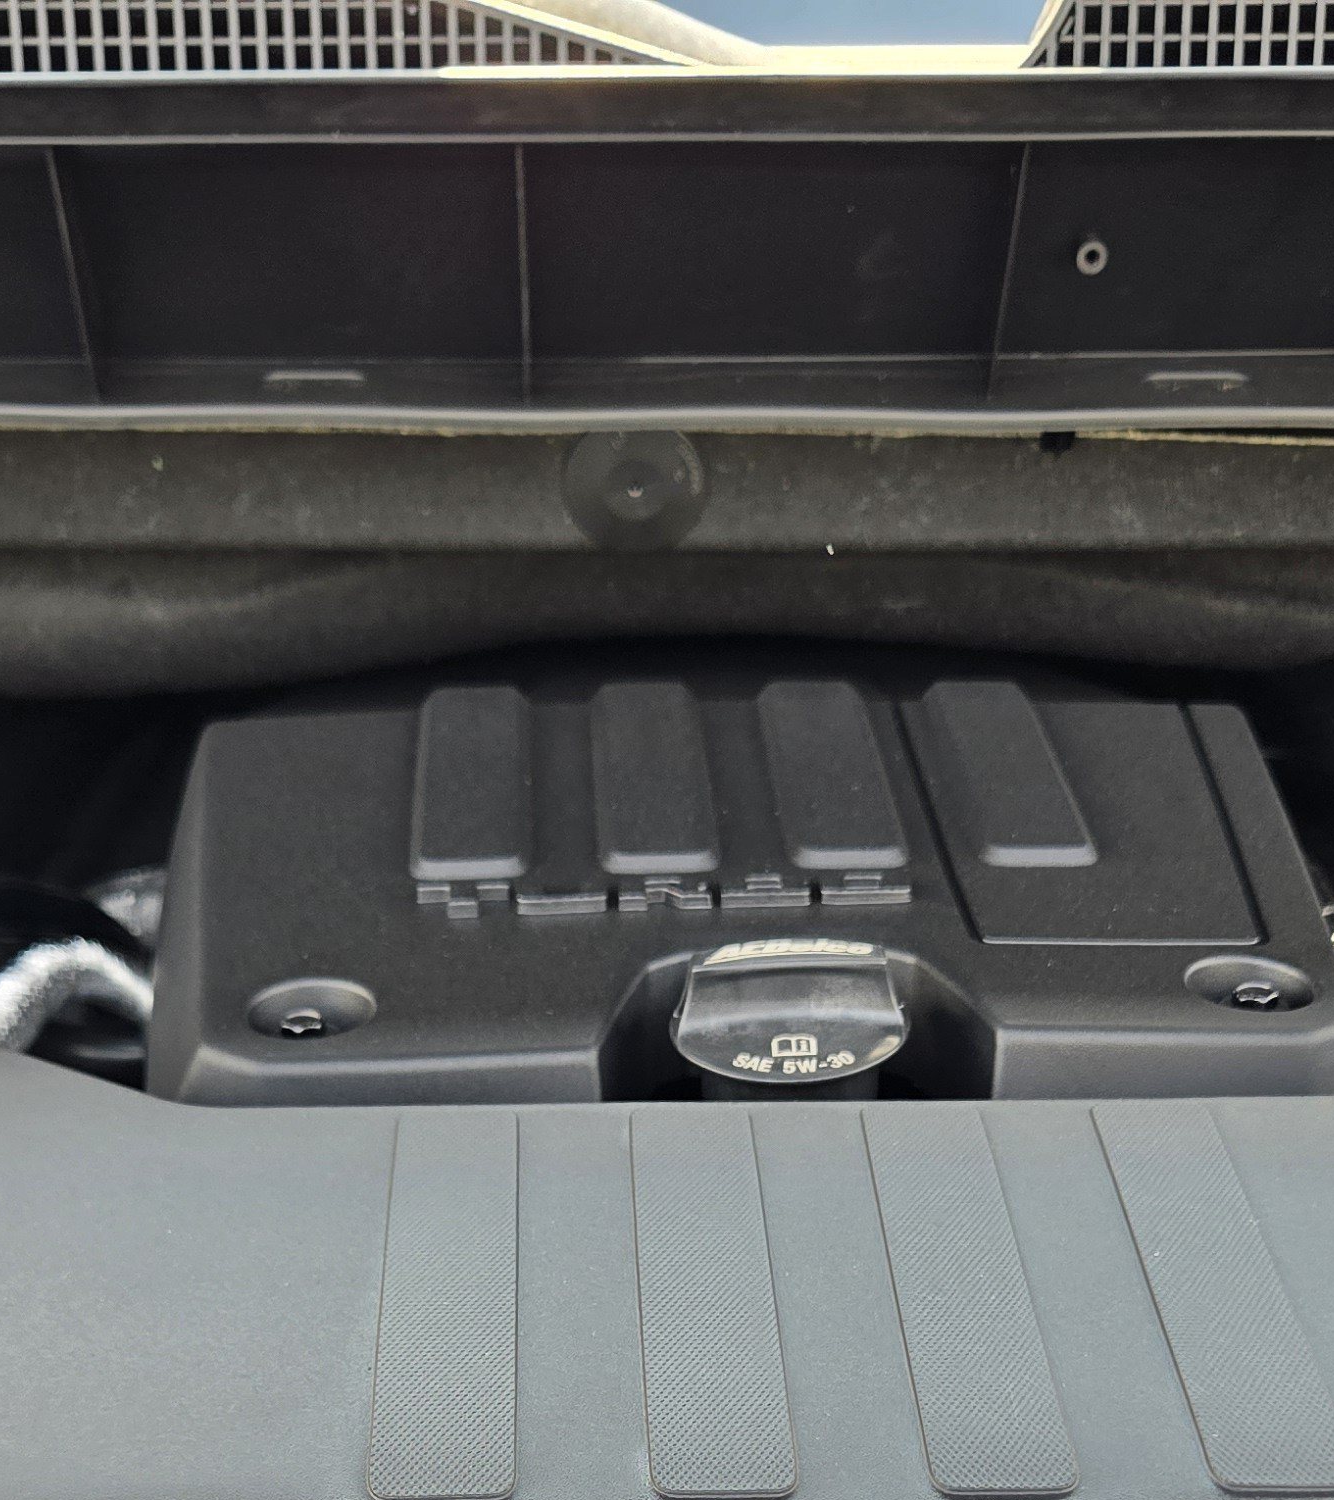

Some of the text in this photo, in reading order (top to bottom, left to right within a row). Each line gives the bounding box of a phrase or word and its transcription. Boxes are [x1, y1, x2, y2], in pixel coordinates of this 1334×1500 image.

[703, 937, 875, 964] ACDelco
[732, 1050, 856, 1074] SAE 5W-30
